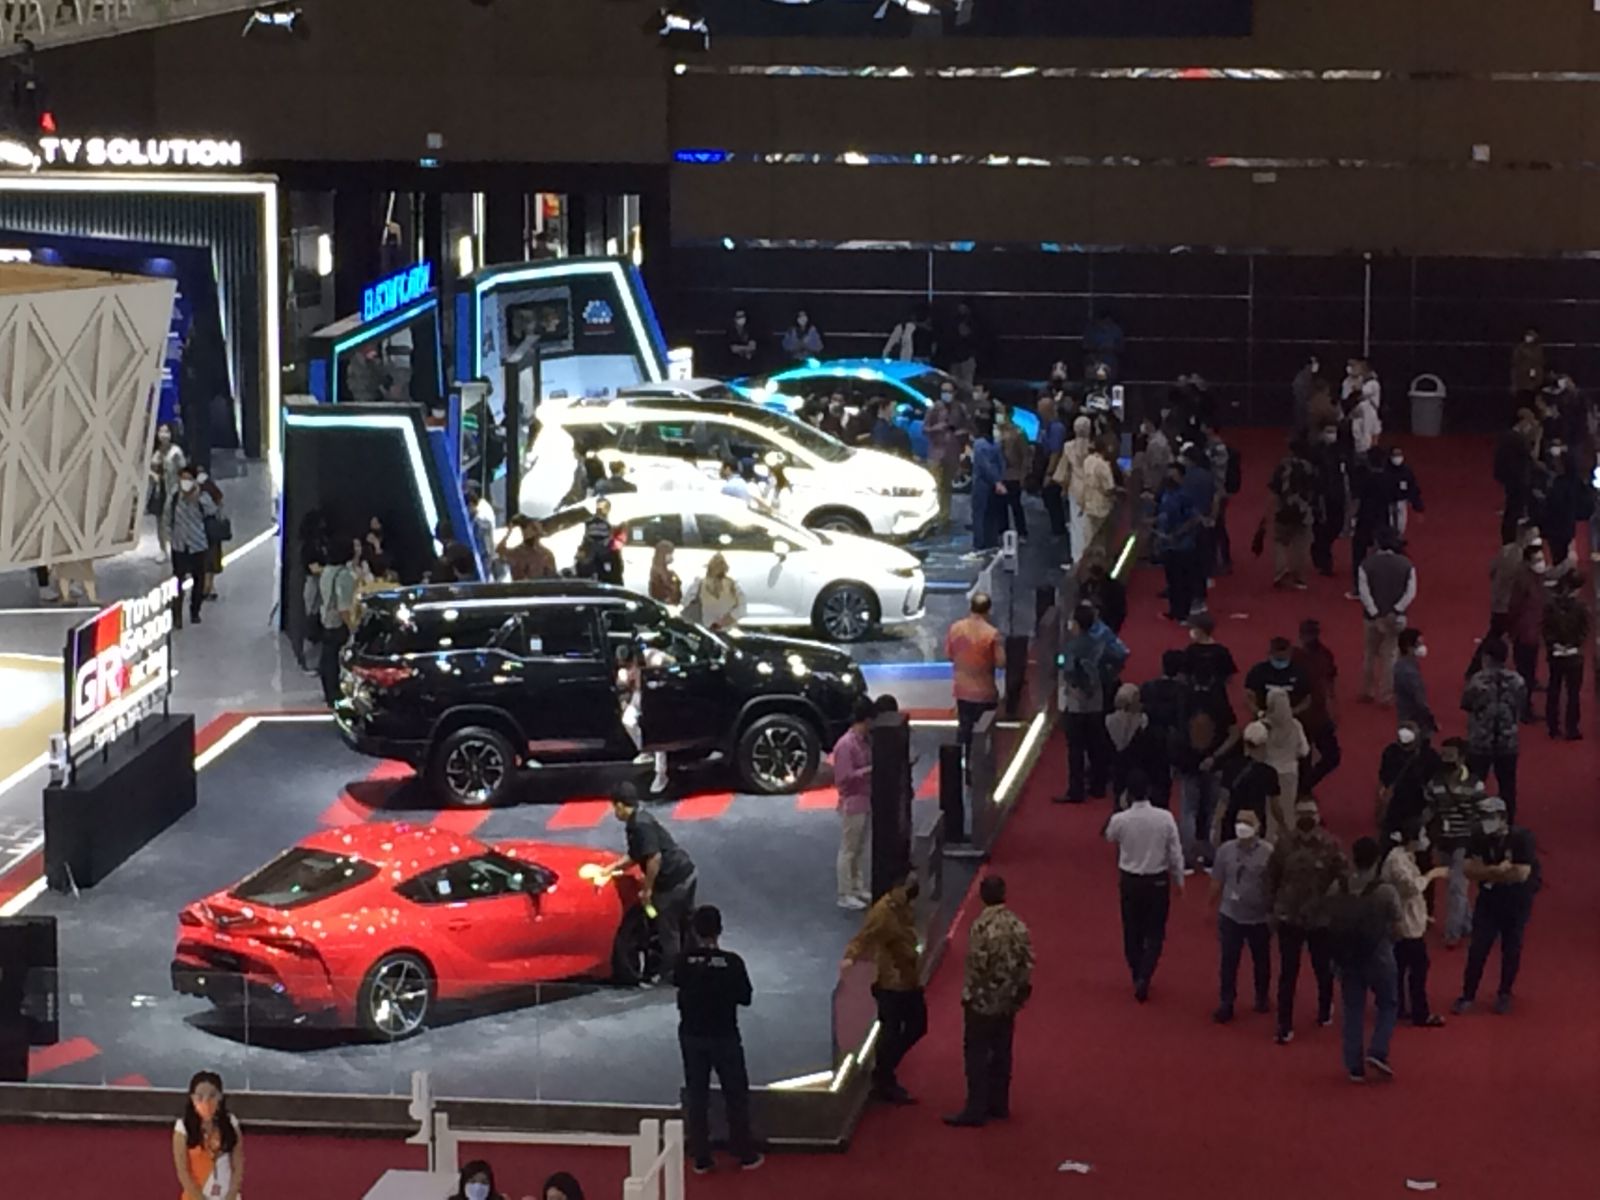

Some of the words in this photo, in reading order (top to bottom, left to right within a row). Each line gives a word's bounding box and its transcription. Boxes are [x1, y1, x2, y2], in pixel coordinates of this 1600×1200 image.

[86, 138, 242, 166] SOLUTION
[123, 577, 178, 628] TOYOTA
[120, 610, 172, 659] GAZOO
[75, 645, 121, 720] GR
